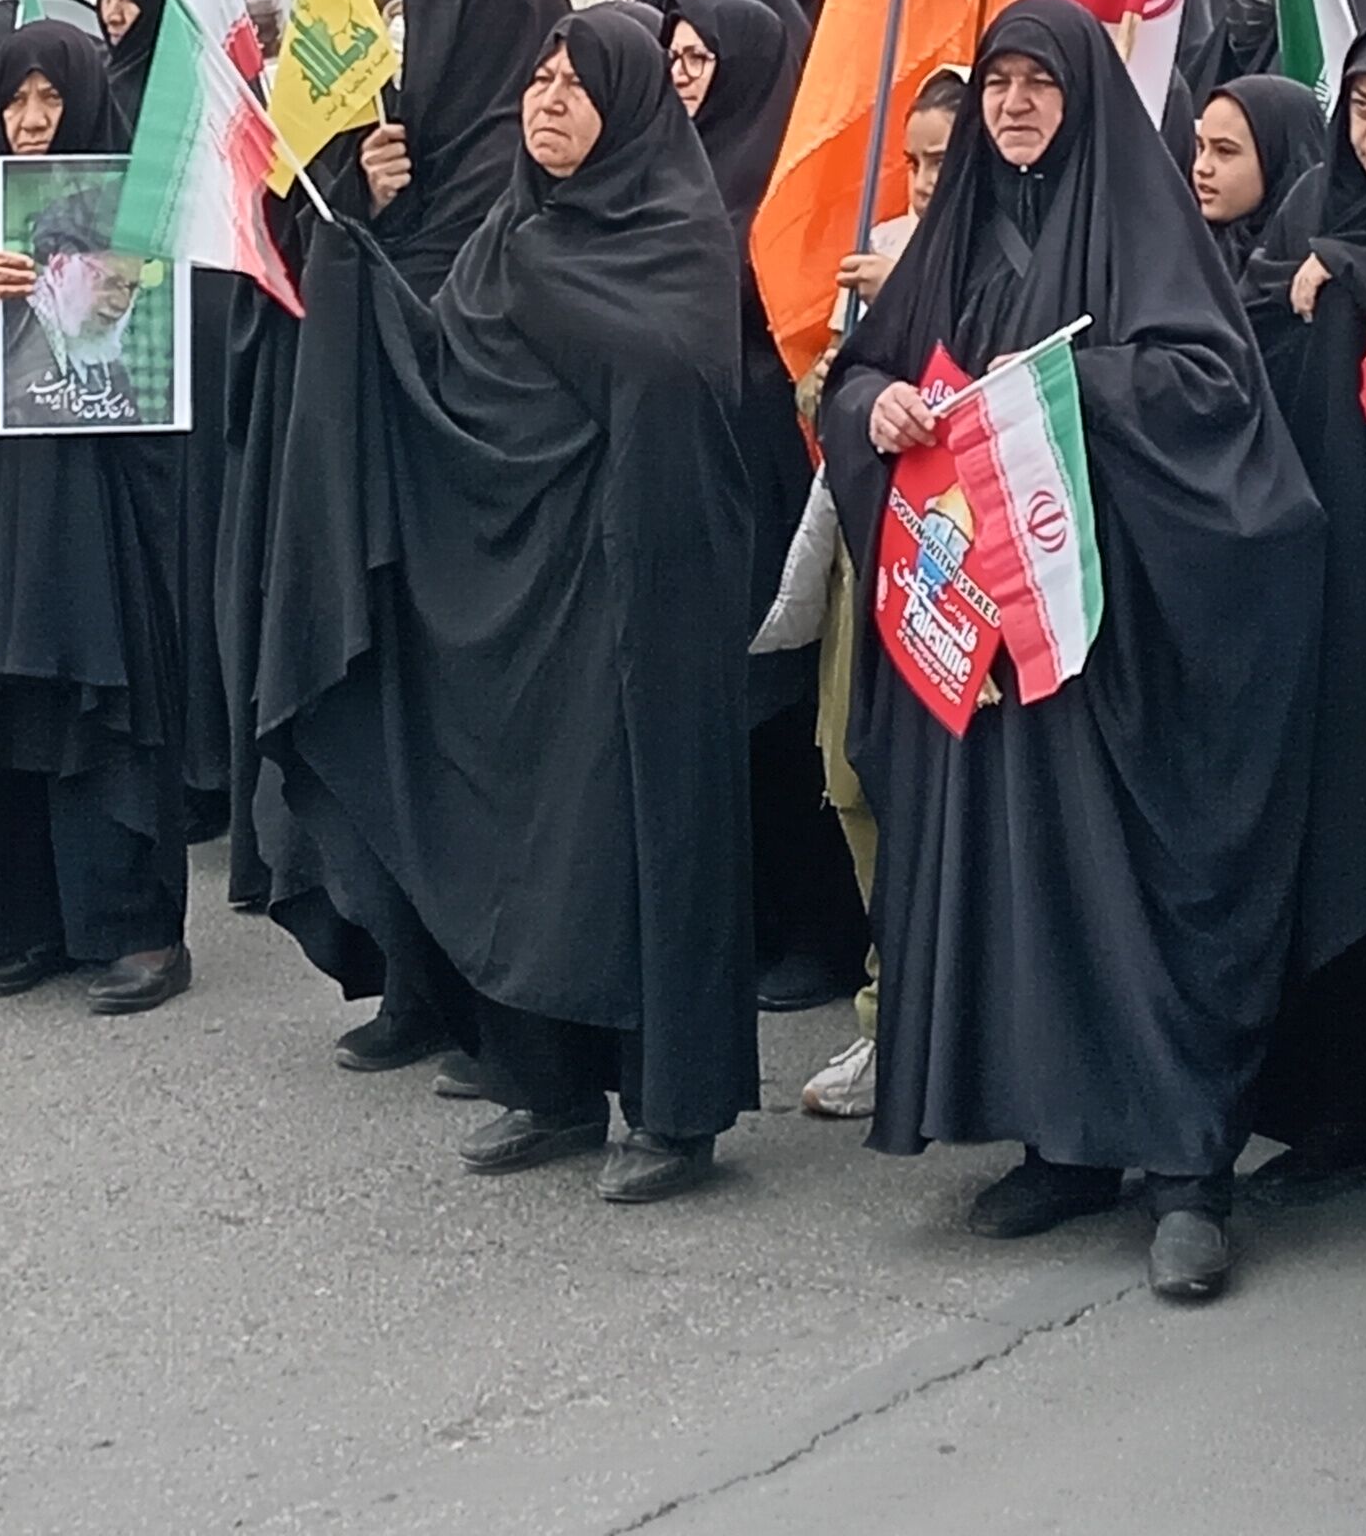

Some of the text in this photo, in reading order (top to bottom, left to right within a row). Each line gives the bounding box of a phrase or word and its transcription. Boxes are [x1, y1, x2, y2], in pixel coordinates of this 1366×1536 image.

[889, 490, 926, 541] DOWN
[925, 536, 957, 579] WITH
[954, 568, 1002, 625] ISRAEL
[902, 585, 972, 684] Palestine
